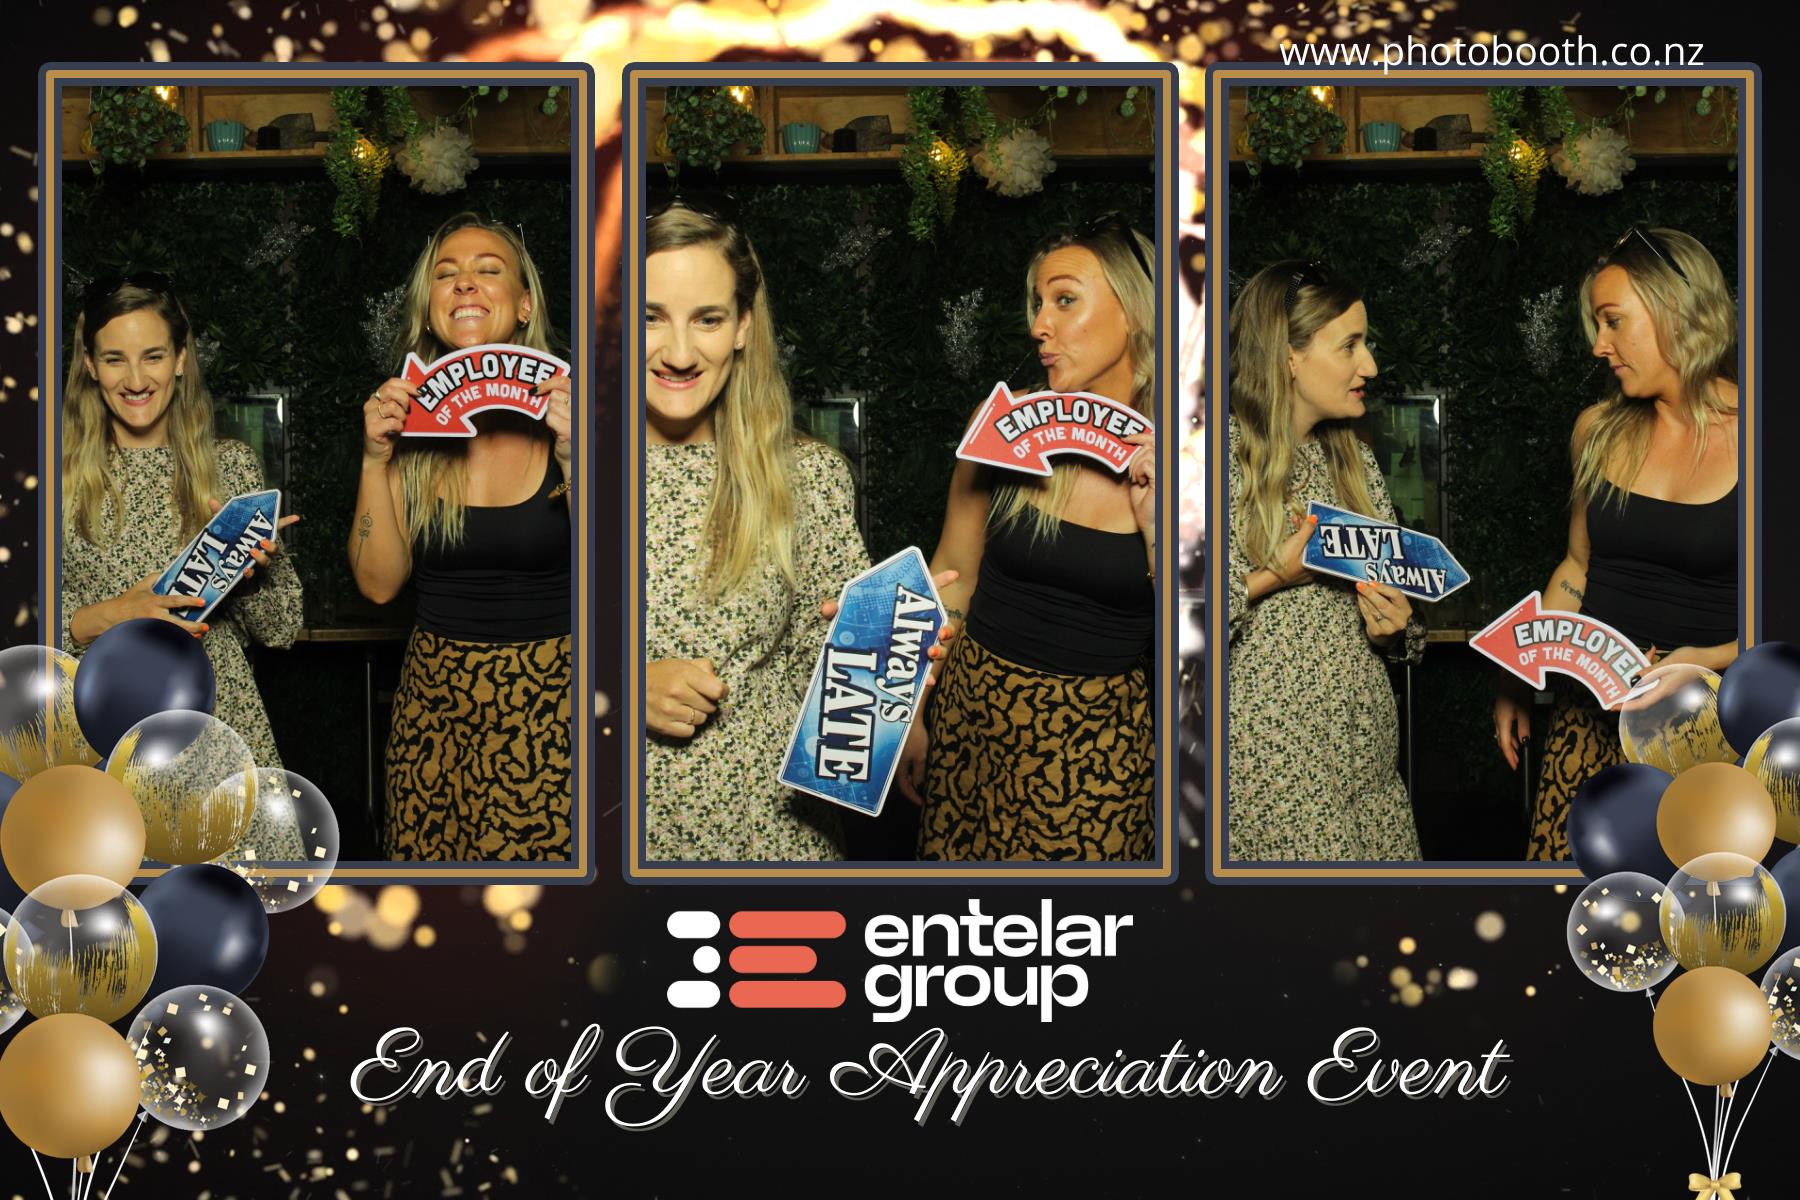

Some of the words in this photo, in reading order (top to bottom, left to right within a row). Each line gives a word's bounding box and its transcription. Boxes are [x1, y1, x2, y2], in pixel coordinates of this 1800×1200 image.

[418, 352, 557, 413] EMPLOYEE
[435, 407, 453, 426] OF
[450, 385, 482, 410] THE
[1012, 438, 1032, 460] OF
[1033, 426, 1067, 446] THE
[1071, 426, 1129, 461] MONTH
[210, 508, 274, 593] Always
[1319, 523, 1404, 560] LATE
[166, 528, 228, 619] LAT
[1365, 559, 1447, 595] Always
[876, 584, 937, 724] Always
[1519, 648, 1537, 666] OF
[1542, 646, 1574, 662] THE
[1575, 653, 1621, 699] MONTH
[816, 642, 879, 783] LATE
